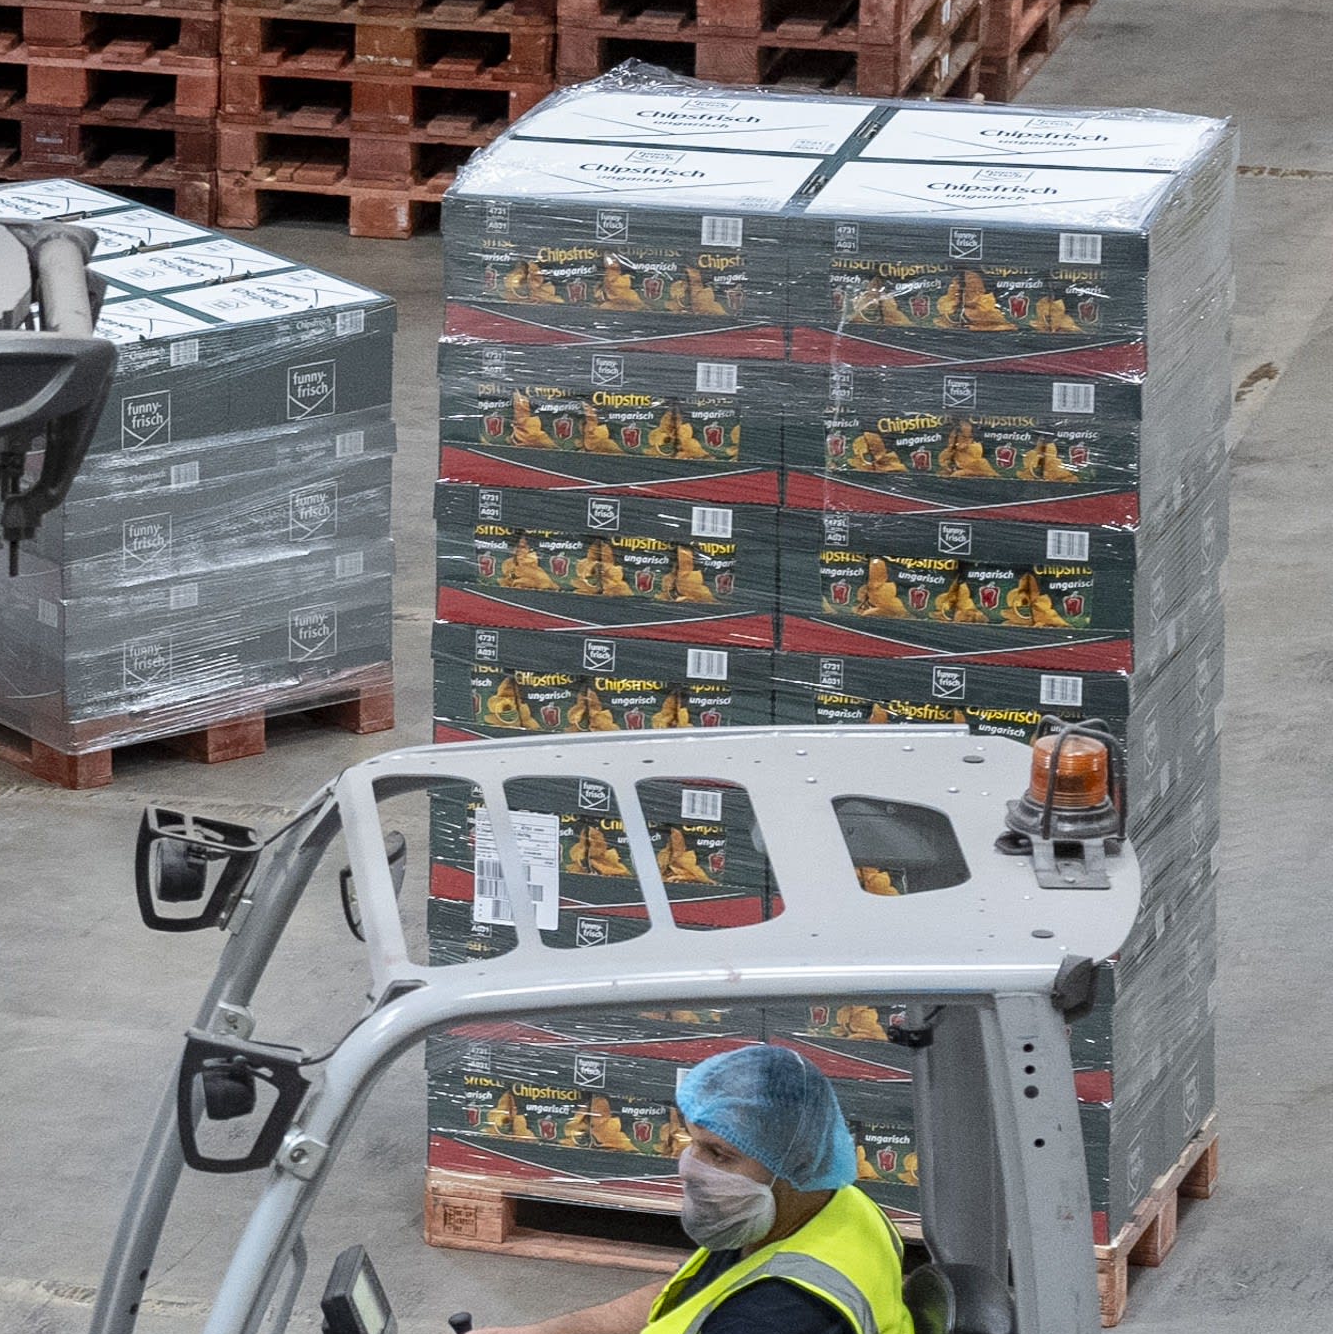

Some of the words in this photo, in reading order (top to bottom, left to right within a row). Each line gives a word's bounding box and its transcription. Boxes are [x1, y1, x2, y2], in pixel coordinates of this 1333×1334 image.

[637, 110, 761, 124] Chipsfrisch
[653, 121, 729, 129] ungarisch
[980, 129, 1108, 143] Chipsfrisch
[998, 139, 1077, 147] ungarisch
[579, 163, 706, 179] Chipsfrisch
[597, 175, 674, 184] ungarisch
[927, 182, 1057, 196] Chipsfrisch
[945, 193, 1026, 201] ungarisch
[957, 239, 978, 247] frisch
[293, 371, 327, 385] funny-
[297, 383, 328, 399] frisch
[950, 387, 971, 395] frisch
[127, 401, 161, 416] funny-
[132, 413, 163, 429] frisch
[609, 411, 653, 421] ungarisch
[897, 433, 941, 445] ungarisch
[985, 431, 1031, 441] ungarisch
[295, 493, 329, 507] funny-
[300, 505, 330, 519] frisch
[129, 523, 163, 537] funny-
[945, 533, 966, 543] frisch
[133, 536, 165, 551] frisch
[624, 555, 669, 564] ungarisch
[899, 572, 945, 584] ungarisch
[968, 570, 1013, 579] ungarisch
[591, 650, 610, 659] frisch
[939, 678, 961, 687] frisch
[611, 696, 656, 705] ungarisch
[979, 724, 1025, 737] ungarisch
[526, 1105, 569, 1115] ungarisch
[865, 1134, 910, 1144] ungarisch
